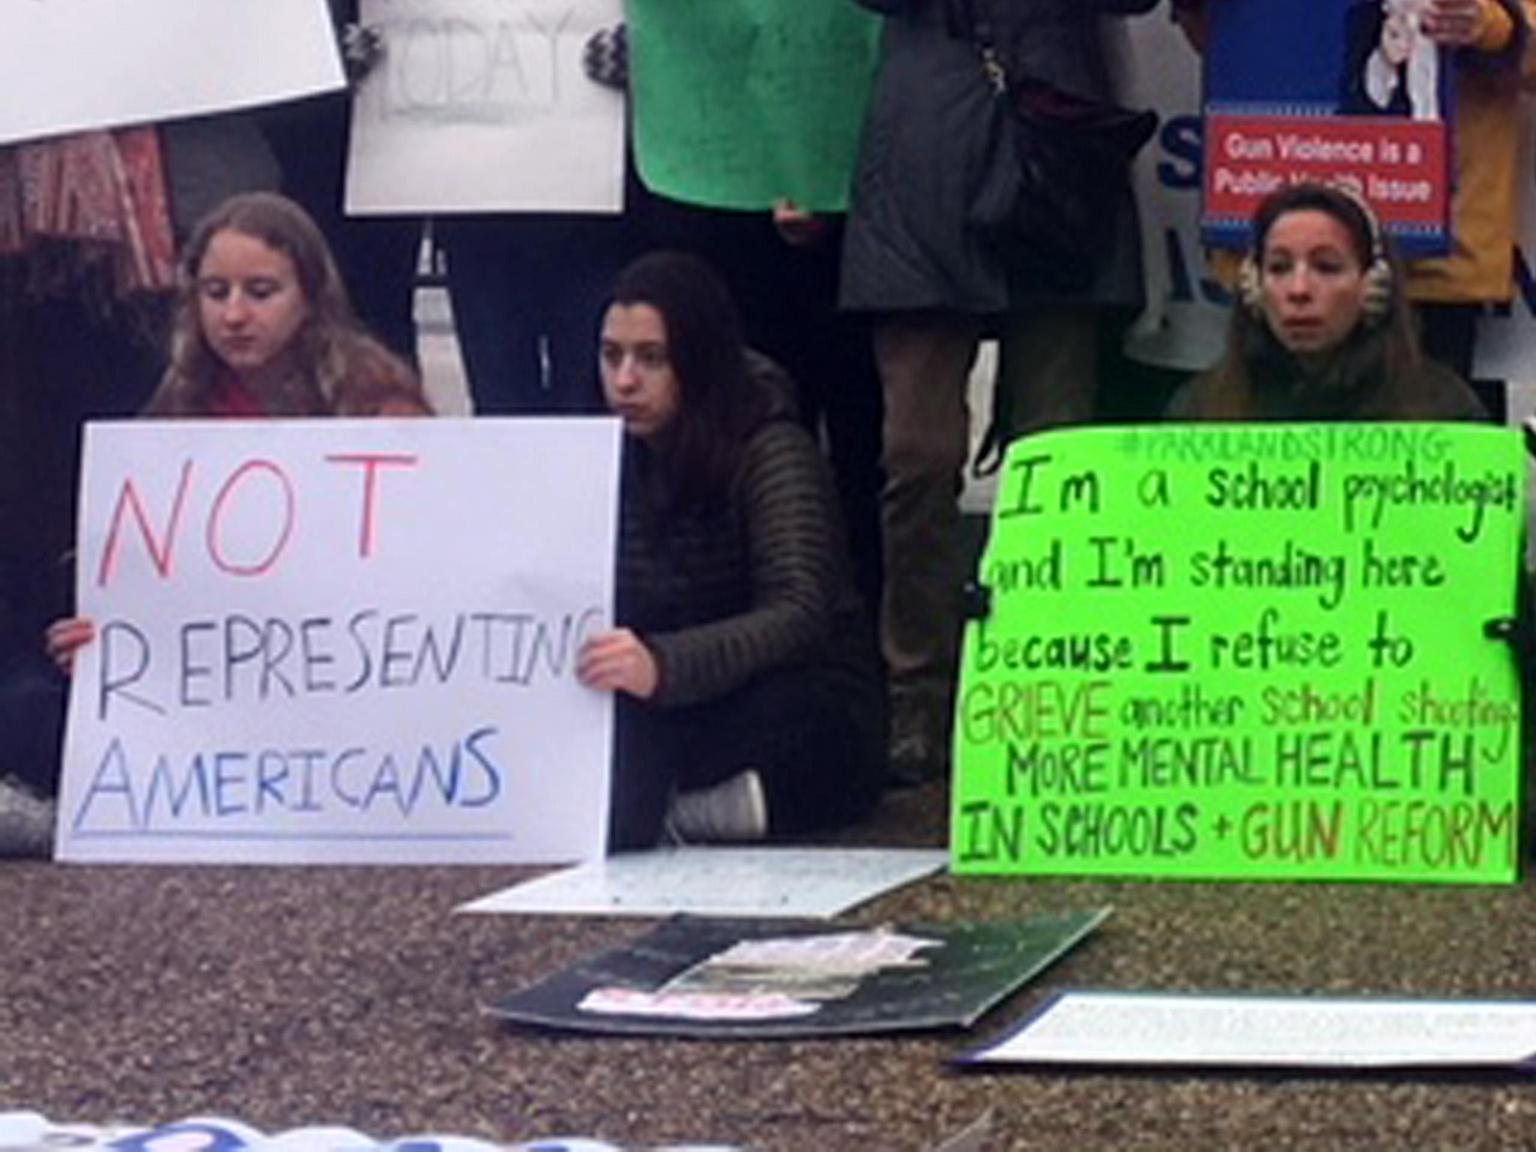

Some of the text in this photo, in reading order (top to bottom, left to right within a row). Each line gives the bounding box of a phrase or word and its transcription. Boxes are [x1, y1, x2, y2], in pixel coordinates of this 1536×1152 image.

[1224, 131, 1422, 164] Gun Violence is a
[1213, 166, 1284, 195] Public
[1366, 172, 1432, 201] Issue
[97, 452, 418, 587] NOT
[1137, 469, 1170, 507] a
[988, 536, 1447, 611] and I'm standing here
[973, 607, 1415, 673] because I refuse to
[961, 679, 1115, 744] GRIEVE
[1120, 683, 1245, 729] another
[72, 726, 501, 833] AMERICANS
[1005, 731, 1476, 797] MORE MENTAL HEALTH
[958, 800, 1024, 863] IN
[1036, 802, 1200, 859] SCHOOLS
[1240, 800, 1343, 860] GUN
[1354, 800, 1516, 869] REFORM
